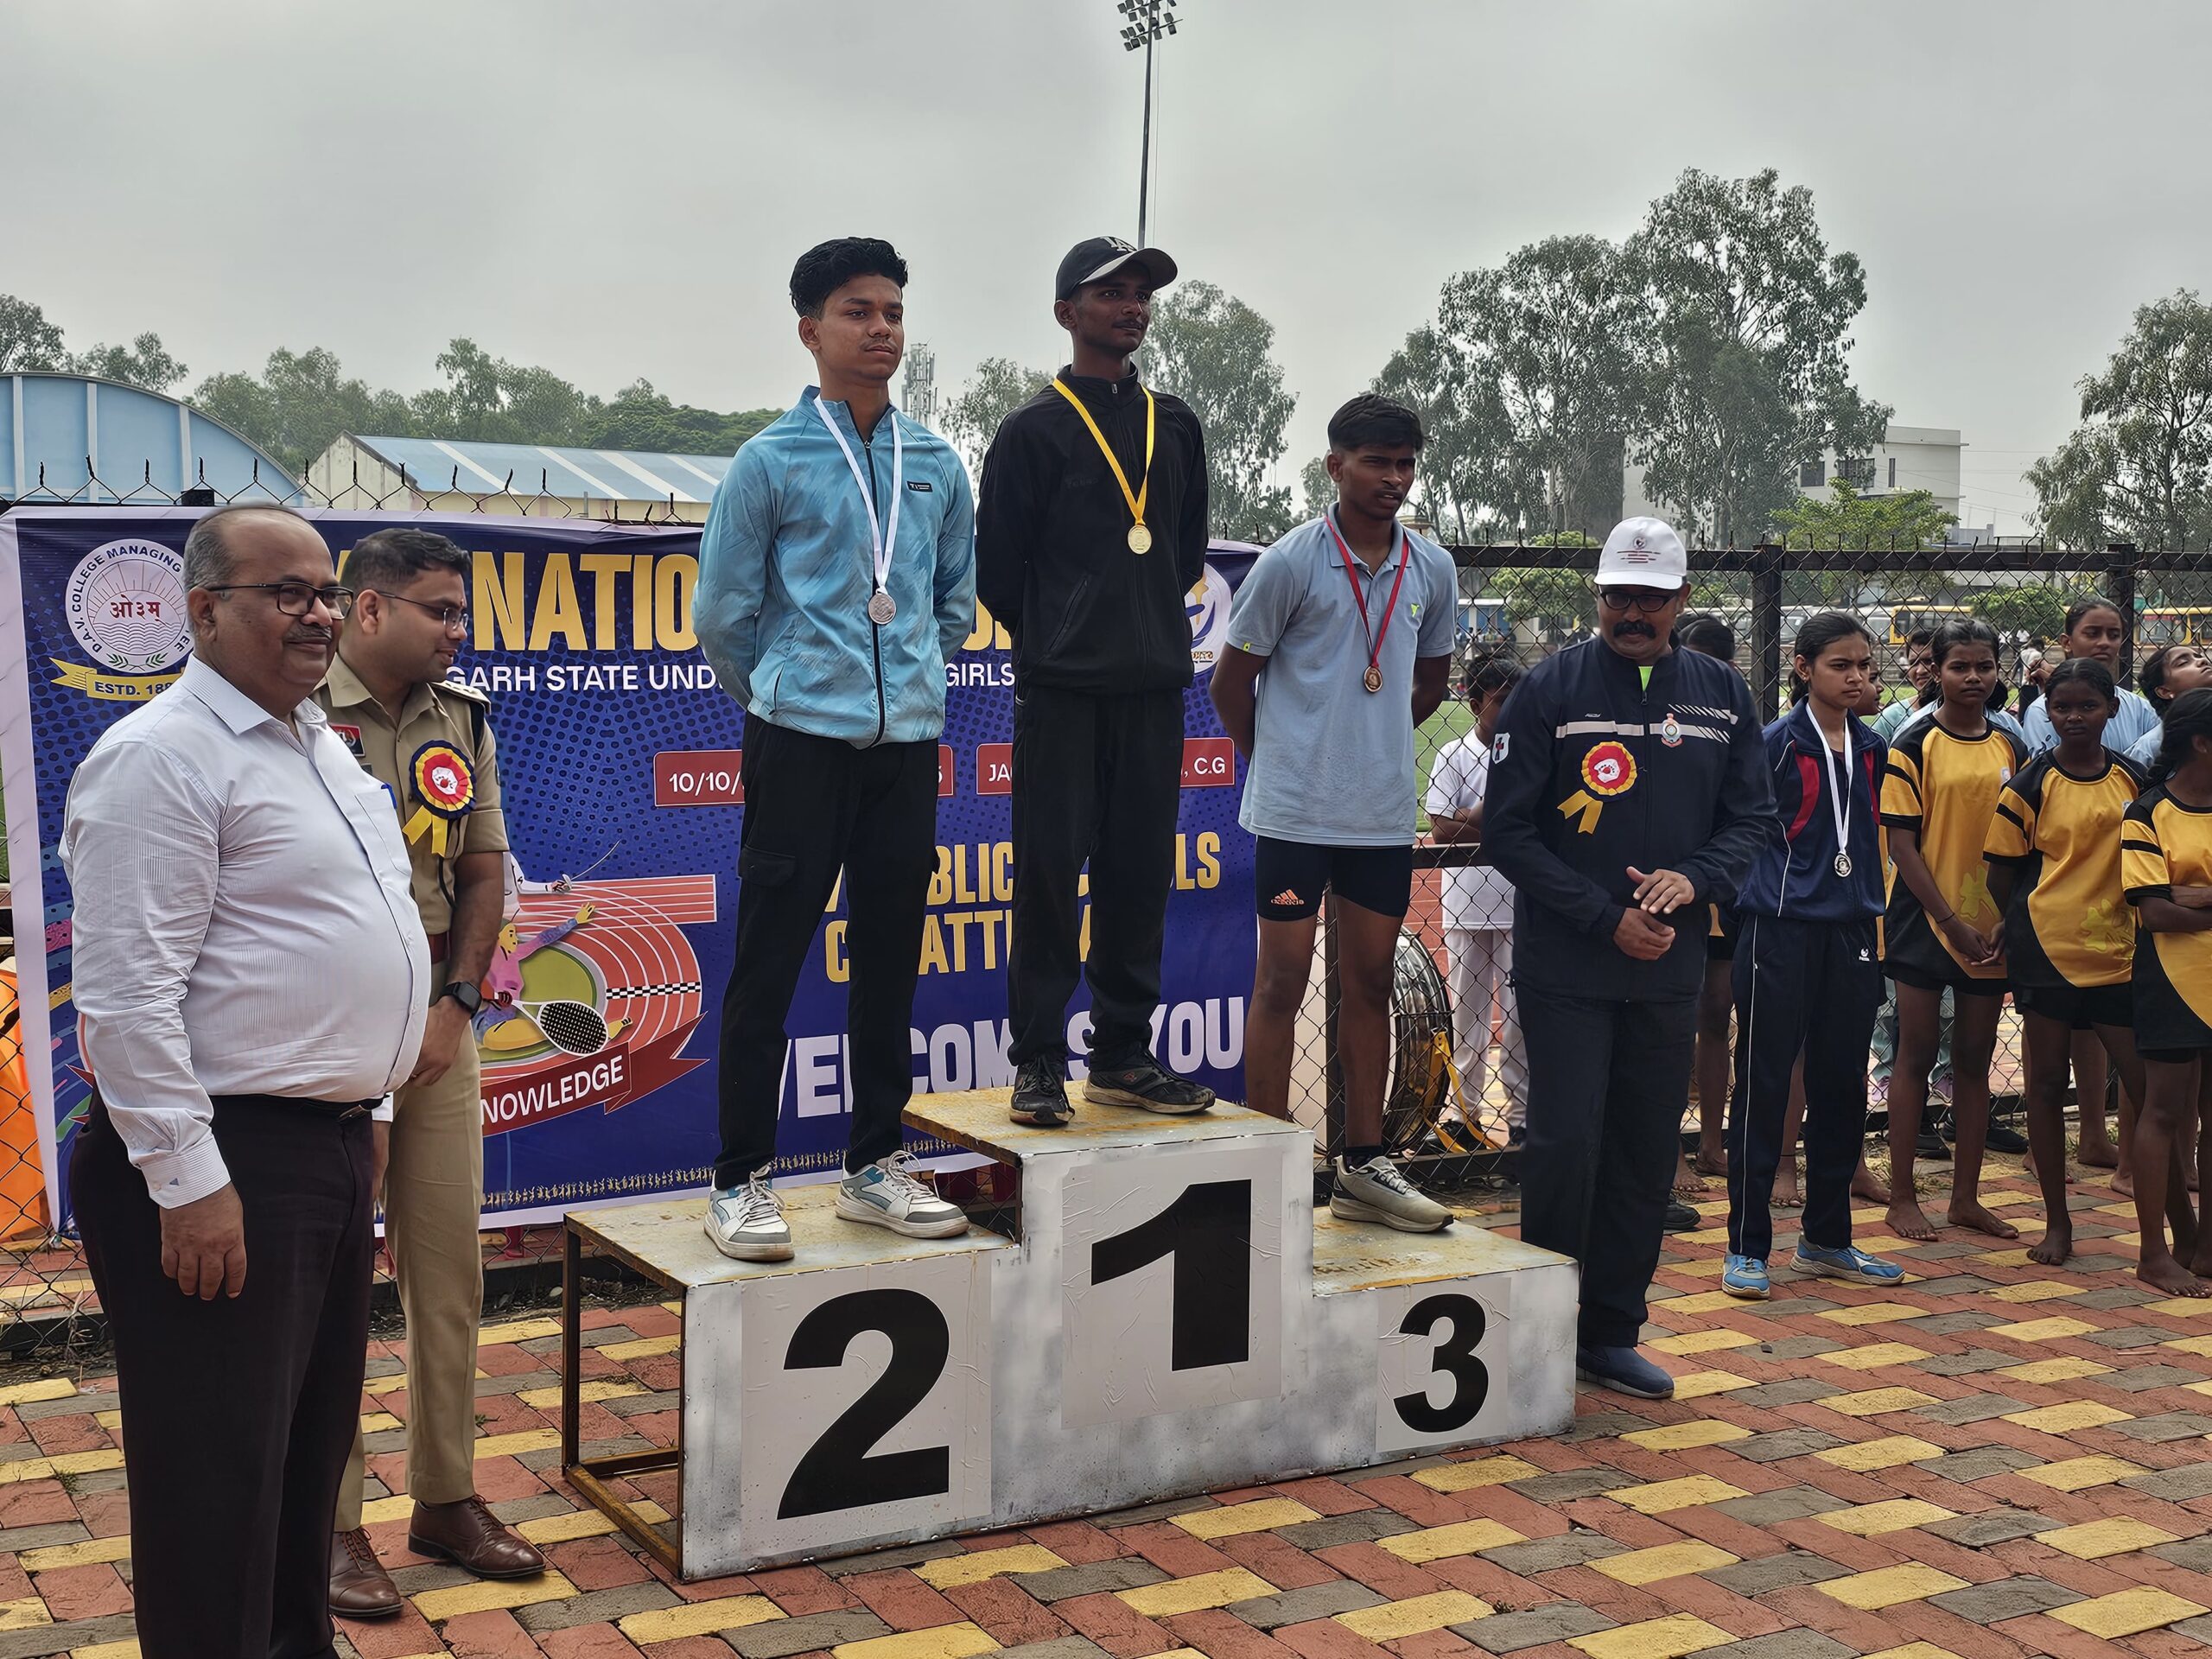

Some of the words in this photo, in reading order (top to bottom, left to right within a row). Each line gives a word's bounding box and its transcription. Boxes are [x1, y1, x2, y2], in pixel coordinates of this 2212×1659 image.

[72, 555, 105, 613] COLLEGE
[106, 545, 182, 573] MANAGING
[472, 551, 700, 651] NATIO
[74, 617, 103, 653] D.A.V.
[95, 681, 141, 696] ESTD.
[145, 682, 173, 695] 188
[446, 665, 535, 691] GARH
[546, 665, 639, 691] STATE
[649, 664, 723, 690] UND
[945, 663, 1015, 687] GIRLS
[669, 771, 744, 796] 10/10/
[1193, 756, 1225, 775] C.G
[926, 842, 1014, 906] BLIC
[480, 1055, 624, 1126] NOWLEDGE
[1090, 1179, 1252, 1371] 1
[1393, 1294, 1490, 1433] 3
[776, 1287, 950, 1521] 2
